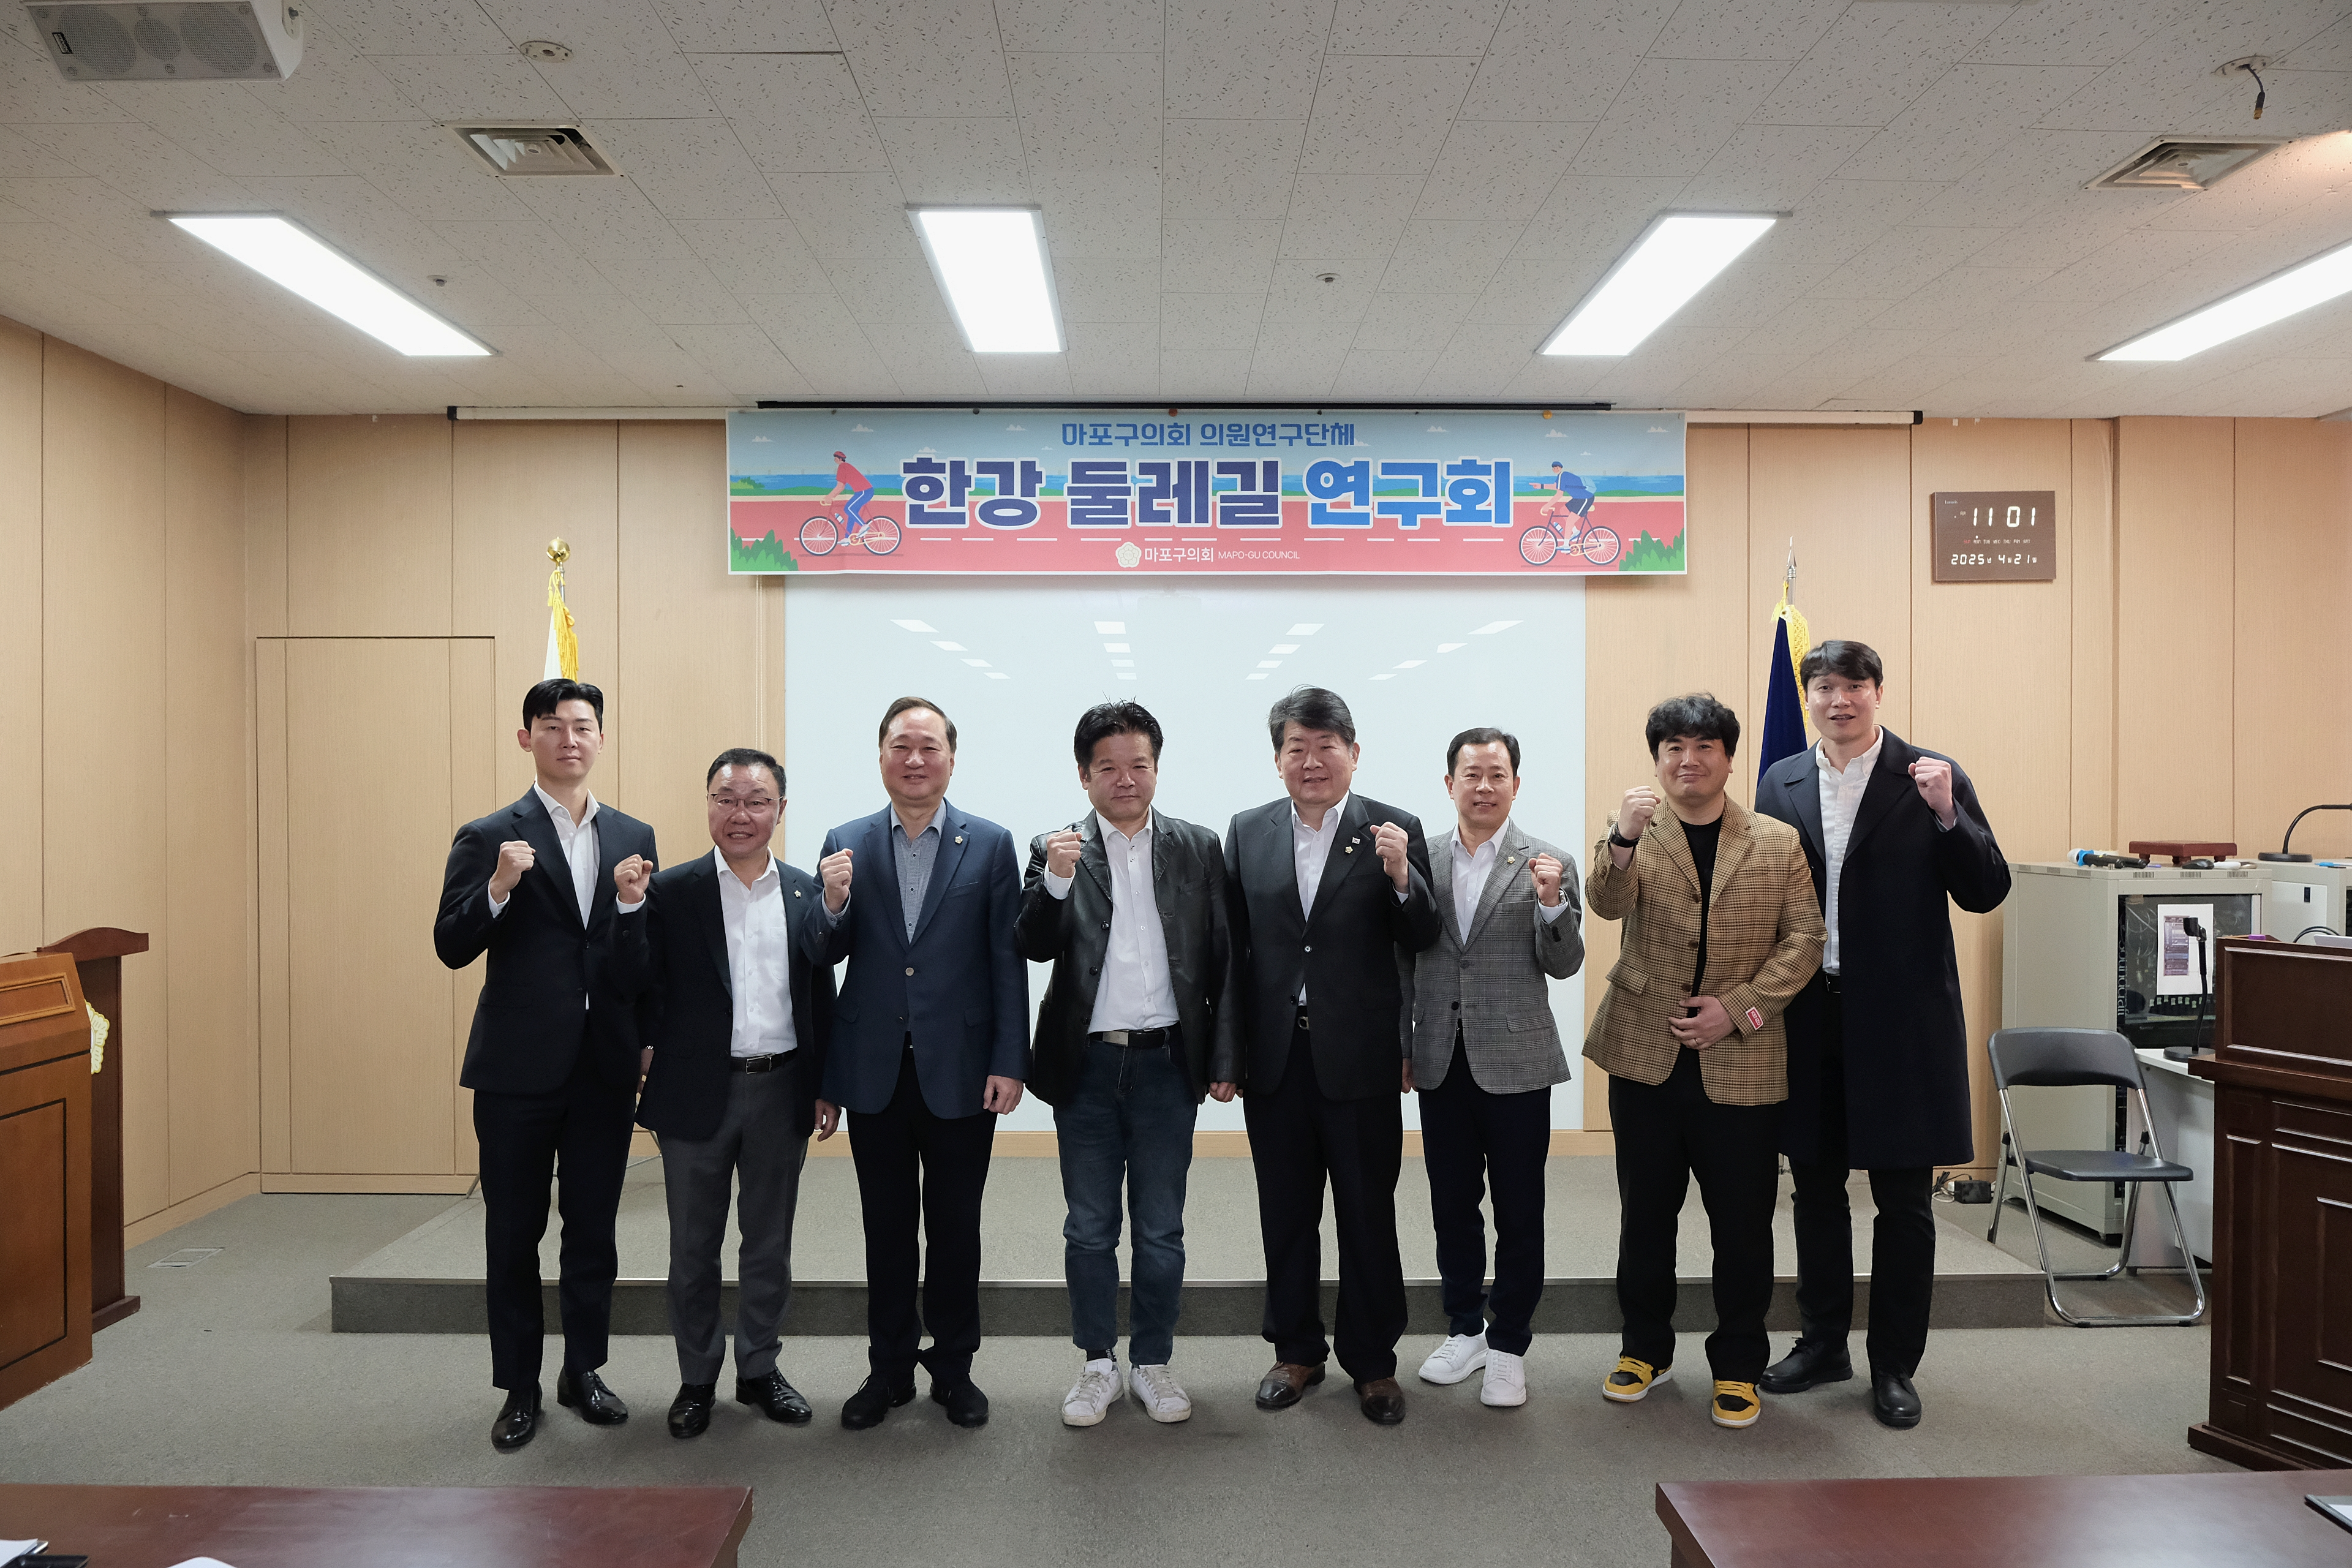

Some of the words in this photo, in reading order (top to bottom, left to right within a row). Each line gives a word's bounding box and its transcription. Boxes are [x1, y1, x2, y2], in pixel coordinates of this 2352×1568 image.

[1061, 422, 1191, 447] 마포구의회
[1199, 422, 1355, 447] 의원연구단체
[902, 457, 1044, 527] 한강
[1066, 459, 1281, 526] 둘레길
[1303, 458, 1513, 527] 연구회
[1144, 547, 1214, 562] 마포구의회
[1218, 551, 1261, 559] MAPO-GU
[1262, 551, 1300, 559] COUNCIL
